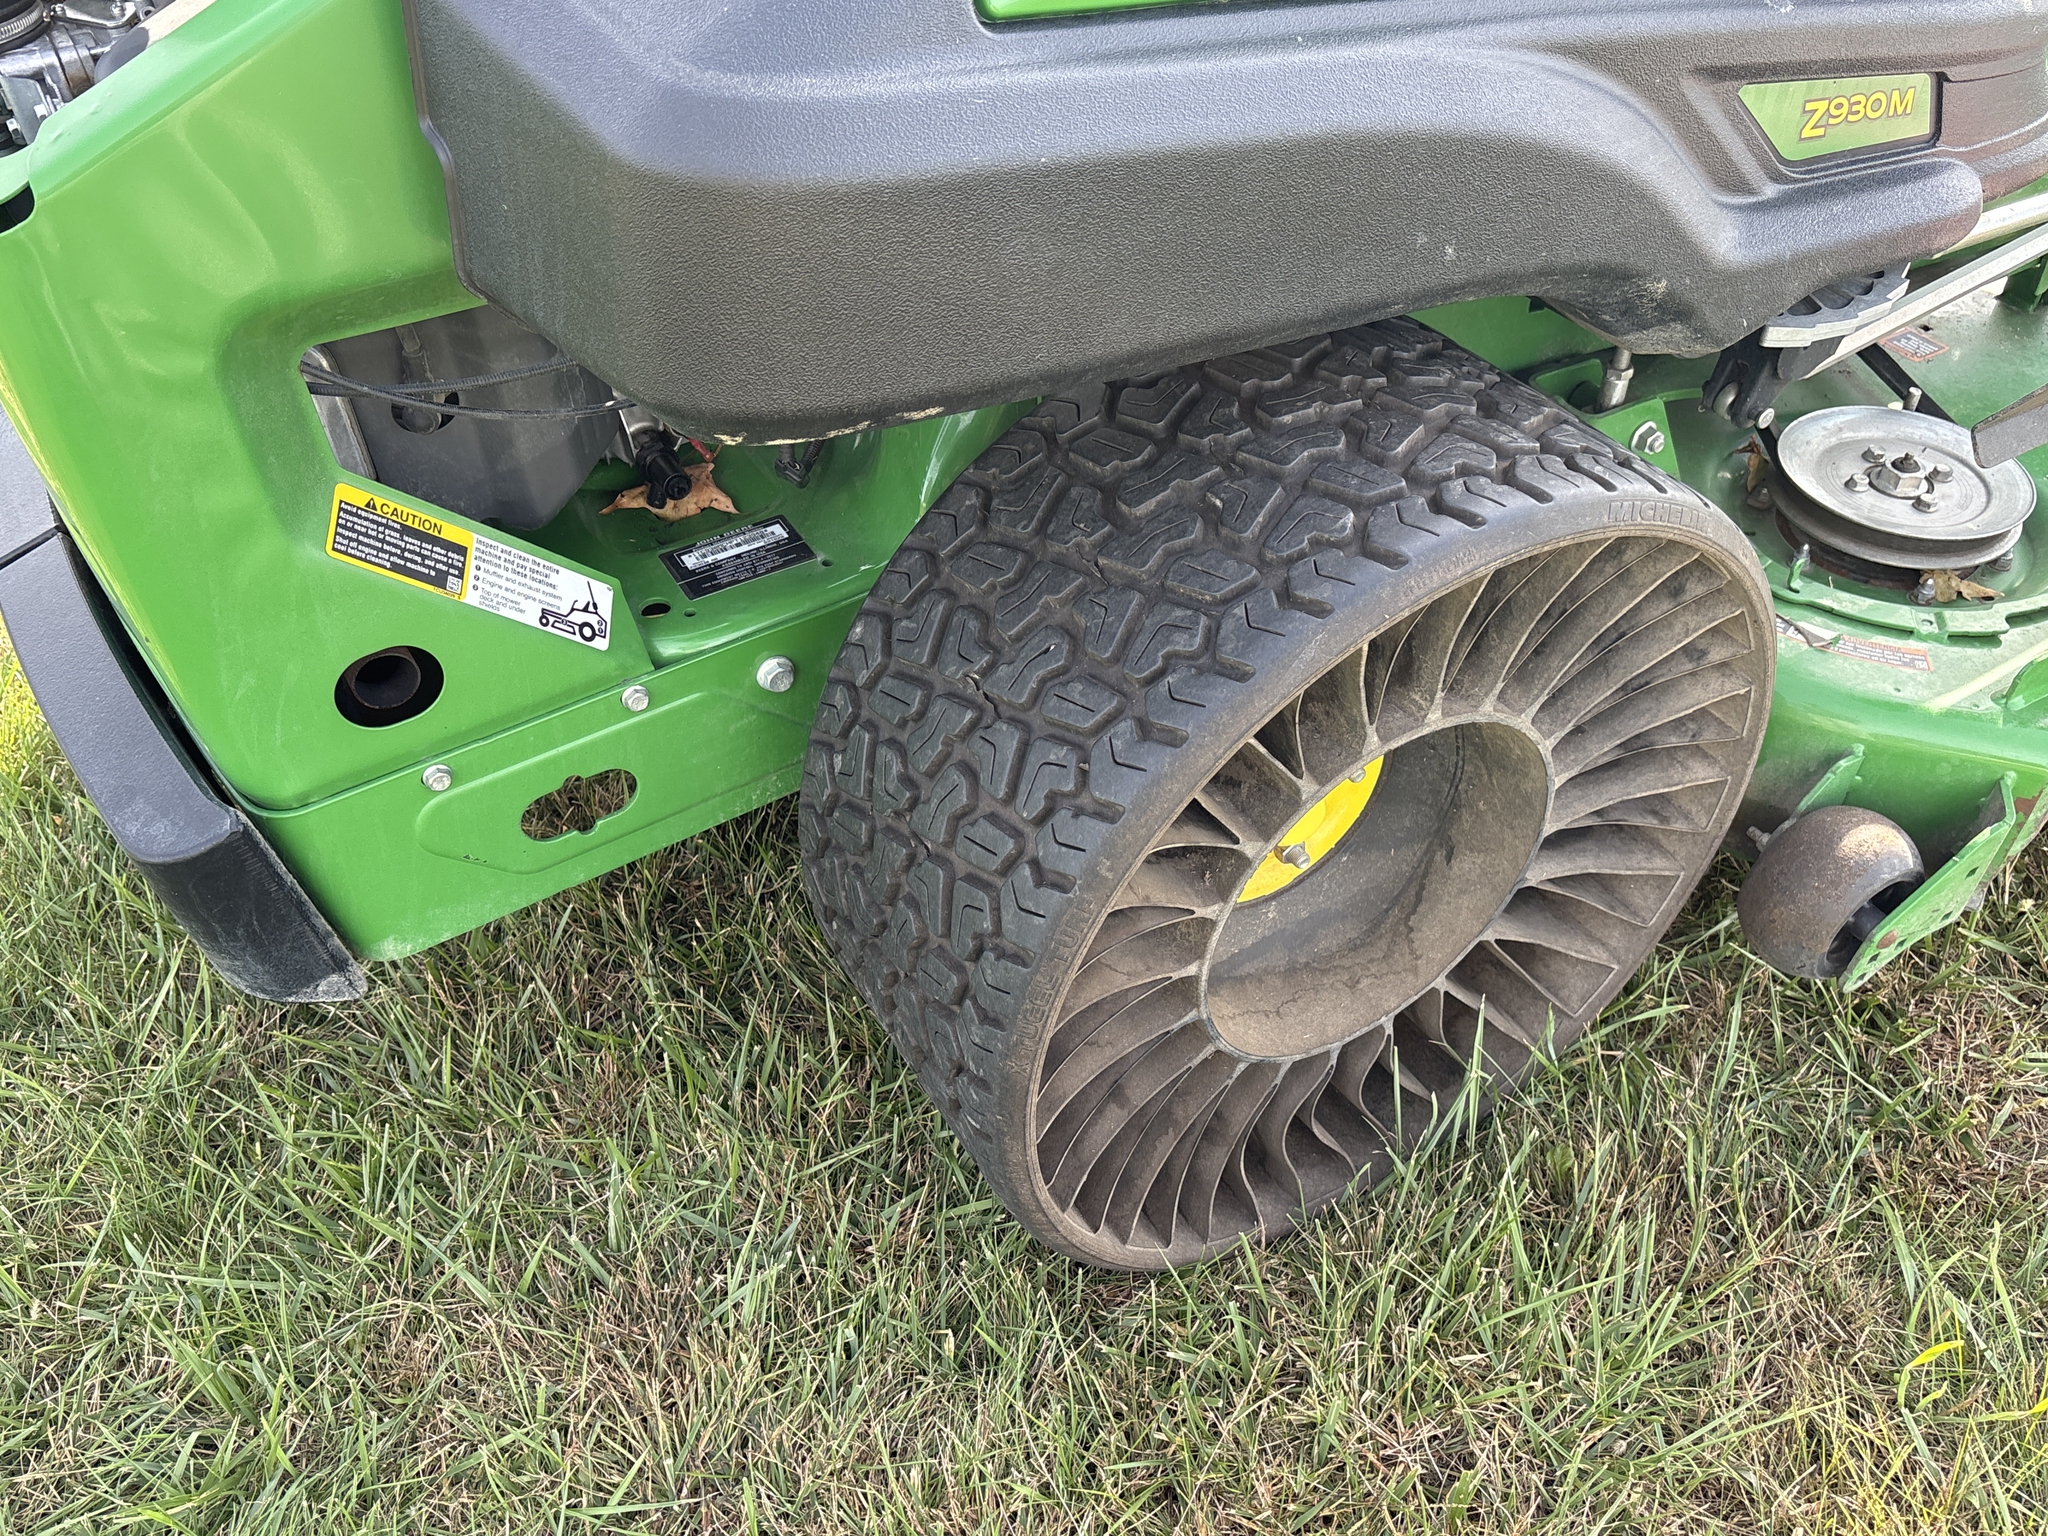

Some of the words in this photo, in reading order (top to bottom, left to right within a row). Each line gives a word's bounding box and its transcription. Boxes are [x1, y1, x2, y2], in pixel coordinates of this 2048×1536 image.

[1799, 86, 1916, 141] Z930M
[341, 502, 357, 514] Avoid
[357, 509, 387, 525] equipment
[388, 520, 403, 530] fires.
[380, 503, 442, 535] CAUTION
[337, 527, 357, 540] Inspect
[358, 534, 382, 548] machine
[383, 543, 403, 556] before,
[404, 551, 424, 563] during,
[424, 558, 435, 567] and
[436, 562, 448, 572] after
[449, 567, 461, 576] use.
[338, 518, 346, 526] on
[347, 521, 353, 529] or
[354, 524, 367, 534] near
[368, 529, 377, 538] hot
[378, 532, 384, 540] or
[385, 535, 405, 548] moving
[406, 543, 420, 553] parts
[421, 548, 431, 557] can
[432, 552, 447, 563] cause
[453, 559, 464, 569] fire.
[339, 511, 377, 530] Accumulation
[378, 525, 384, 533] of
[403, 534, 421, 546] leaves
[422, 541, 432, 550] and
[433, 545, 447, 556] other
[448, 550, 464, 562] debris
[695, 535, 721, 546] JOHN
[723, 524, 754, 537] DEERE
[334, 543, 346, 552] cool
[347, 547, 366, 559] before
[366, 554, 393, 569] cleaning.
[335, 536, 348, 546] Shut
[349, 541, 357, 549] off
[358, 544, 377, 556] engine
[378, 551, 389, 560] and
[390, 555, 405, 566] allow
[406, 561, 429, 574] machine
[430, 569, 436, 577] to
[474, 553, 501, 570] attention
[503, 564, 509, 573] to
[511, 567, 527, 580] these
[529, 574, 558, 591] locations:
[475, 545, 502, 561] machine
[504, 556, 515, 567] and
[517, 561, 527, 571] pay
[529, 566, 550, 580] special
[476, 537, 499, 552] Inspect
[501, 547, 512, 557] and
[513, 552, 530, 564] clean
[531, 559, 540, 569] the
[542, 564, 559, 576] entire
[481, 587, 492, 596] Top
[493, 591, 499, 599] of
[501, 594, 521, 606] mower
[482, 577, 503, 591] Engine
[504, 585, 515, 595] and
[517, 590, 536, 603] engine
[538, 598, 560, 612] screens
[483, 567, 504, 580] Muffler
[505, 575, 516, 585] and
[518, 580, 540, 594] exhaust
[542, 589, 562, 602] system
[479, 600, 500, 612] shields
[480, 594, 494, 603] deck
[496, 599, 507, 608] and
[509, 604, 526, 615] under
[1012, 974, 1063, 1053] TWEEL
